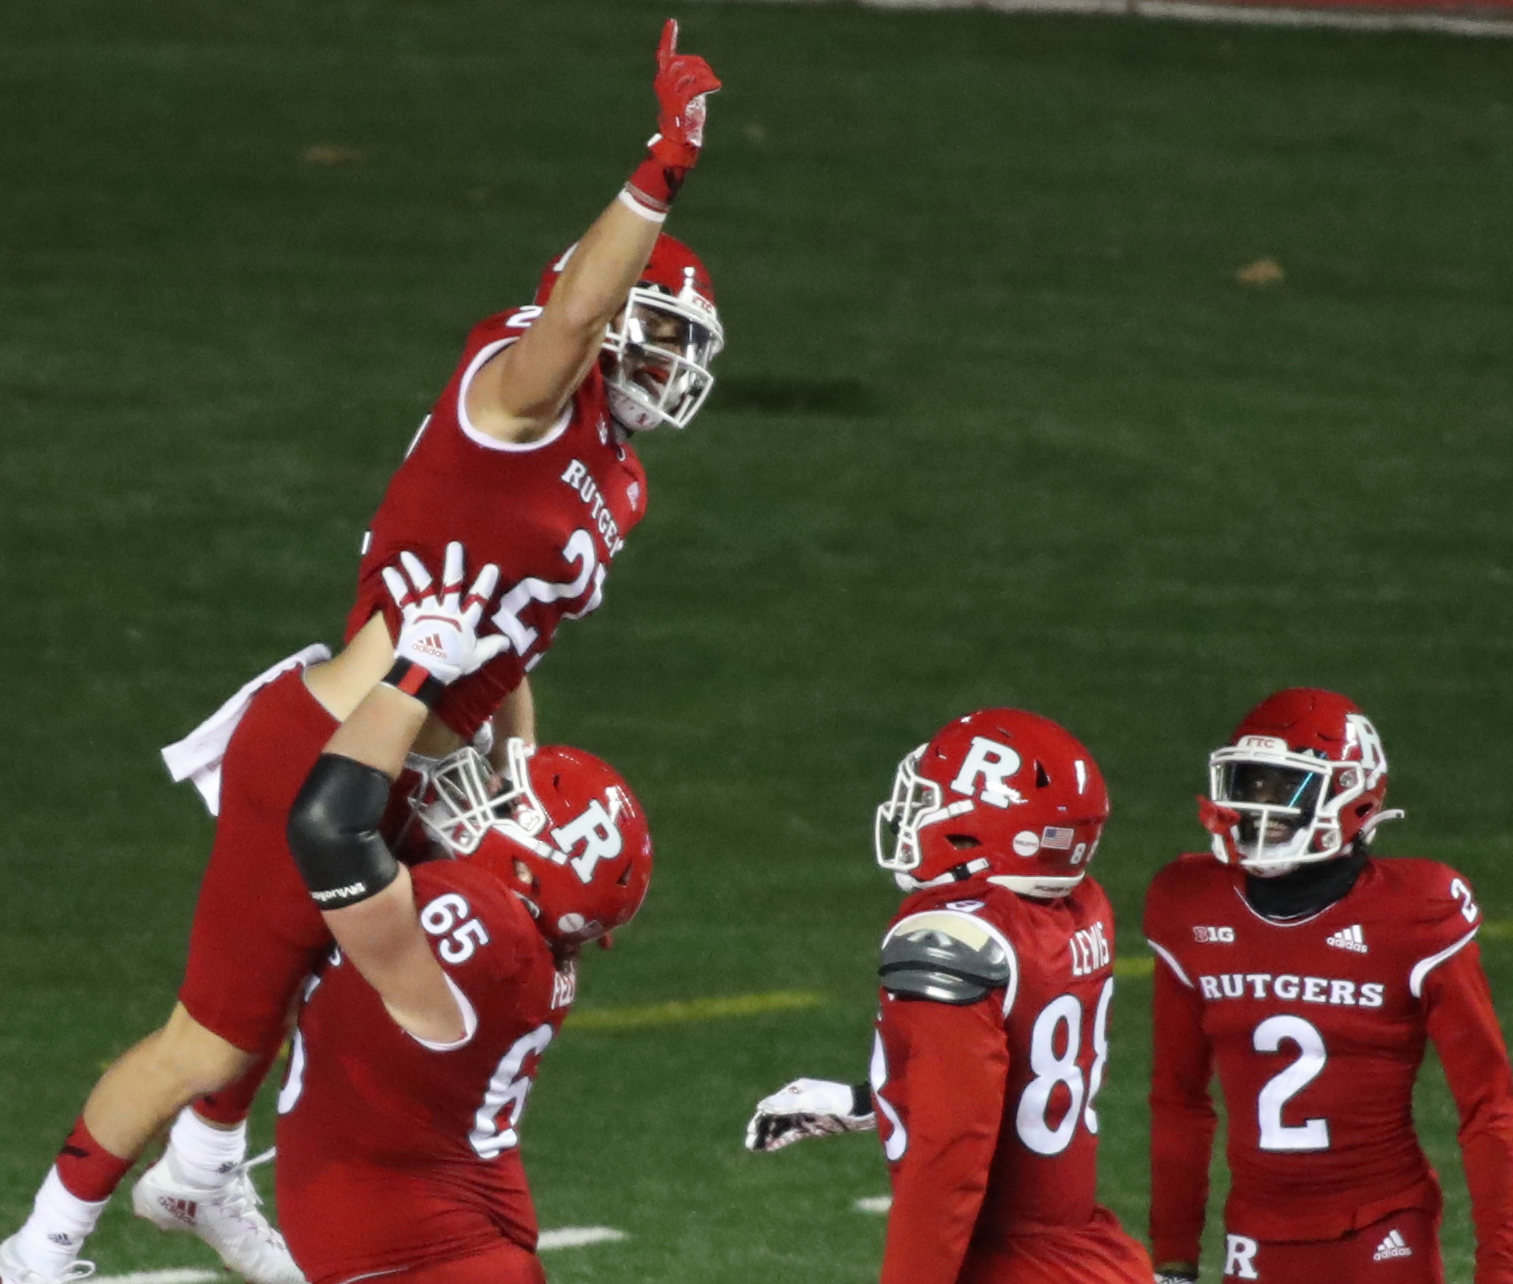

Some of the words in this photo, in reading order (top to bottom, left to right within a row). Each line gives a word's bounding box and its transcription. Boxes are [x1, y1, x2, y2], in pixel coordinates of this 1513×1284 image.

[491, 529, 607, 672] 2
[1246, 737, 1274, 748] FTC
[950, 736, 1022, 809] R
[550, 799, 623, 885] R
[1450, 878, 1478, 923] 2
[420, 893, 489, 964] 65
[1069, 921, 1109, 976] LEWIS
[1326, 935, 1368, 953] adidas
[1199, 973, 1384, 1007] RUTGERS
[1253, 1015, 1329, 1149] 2
[1224, 1233, 1259, 1279] R
